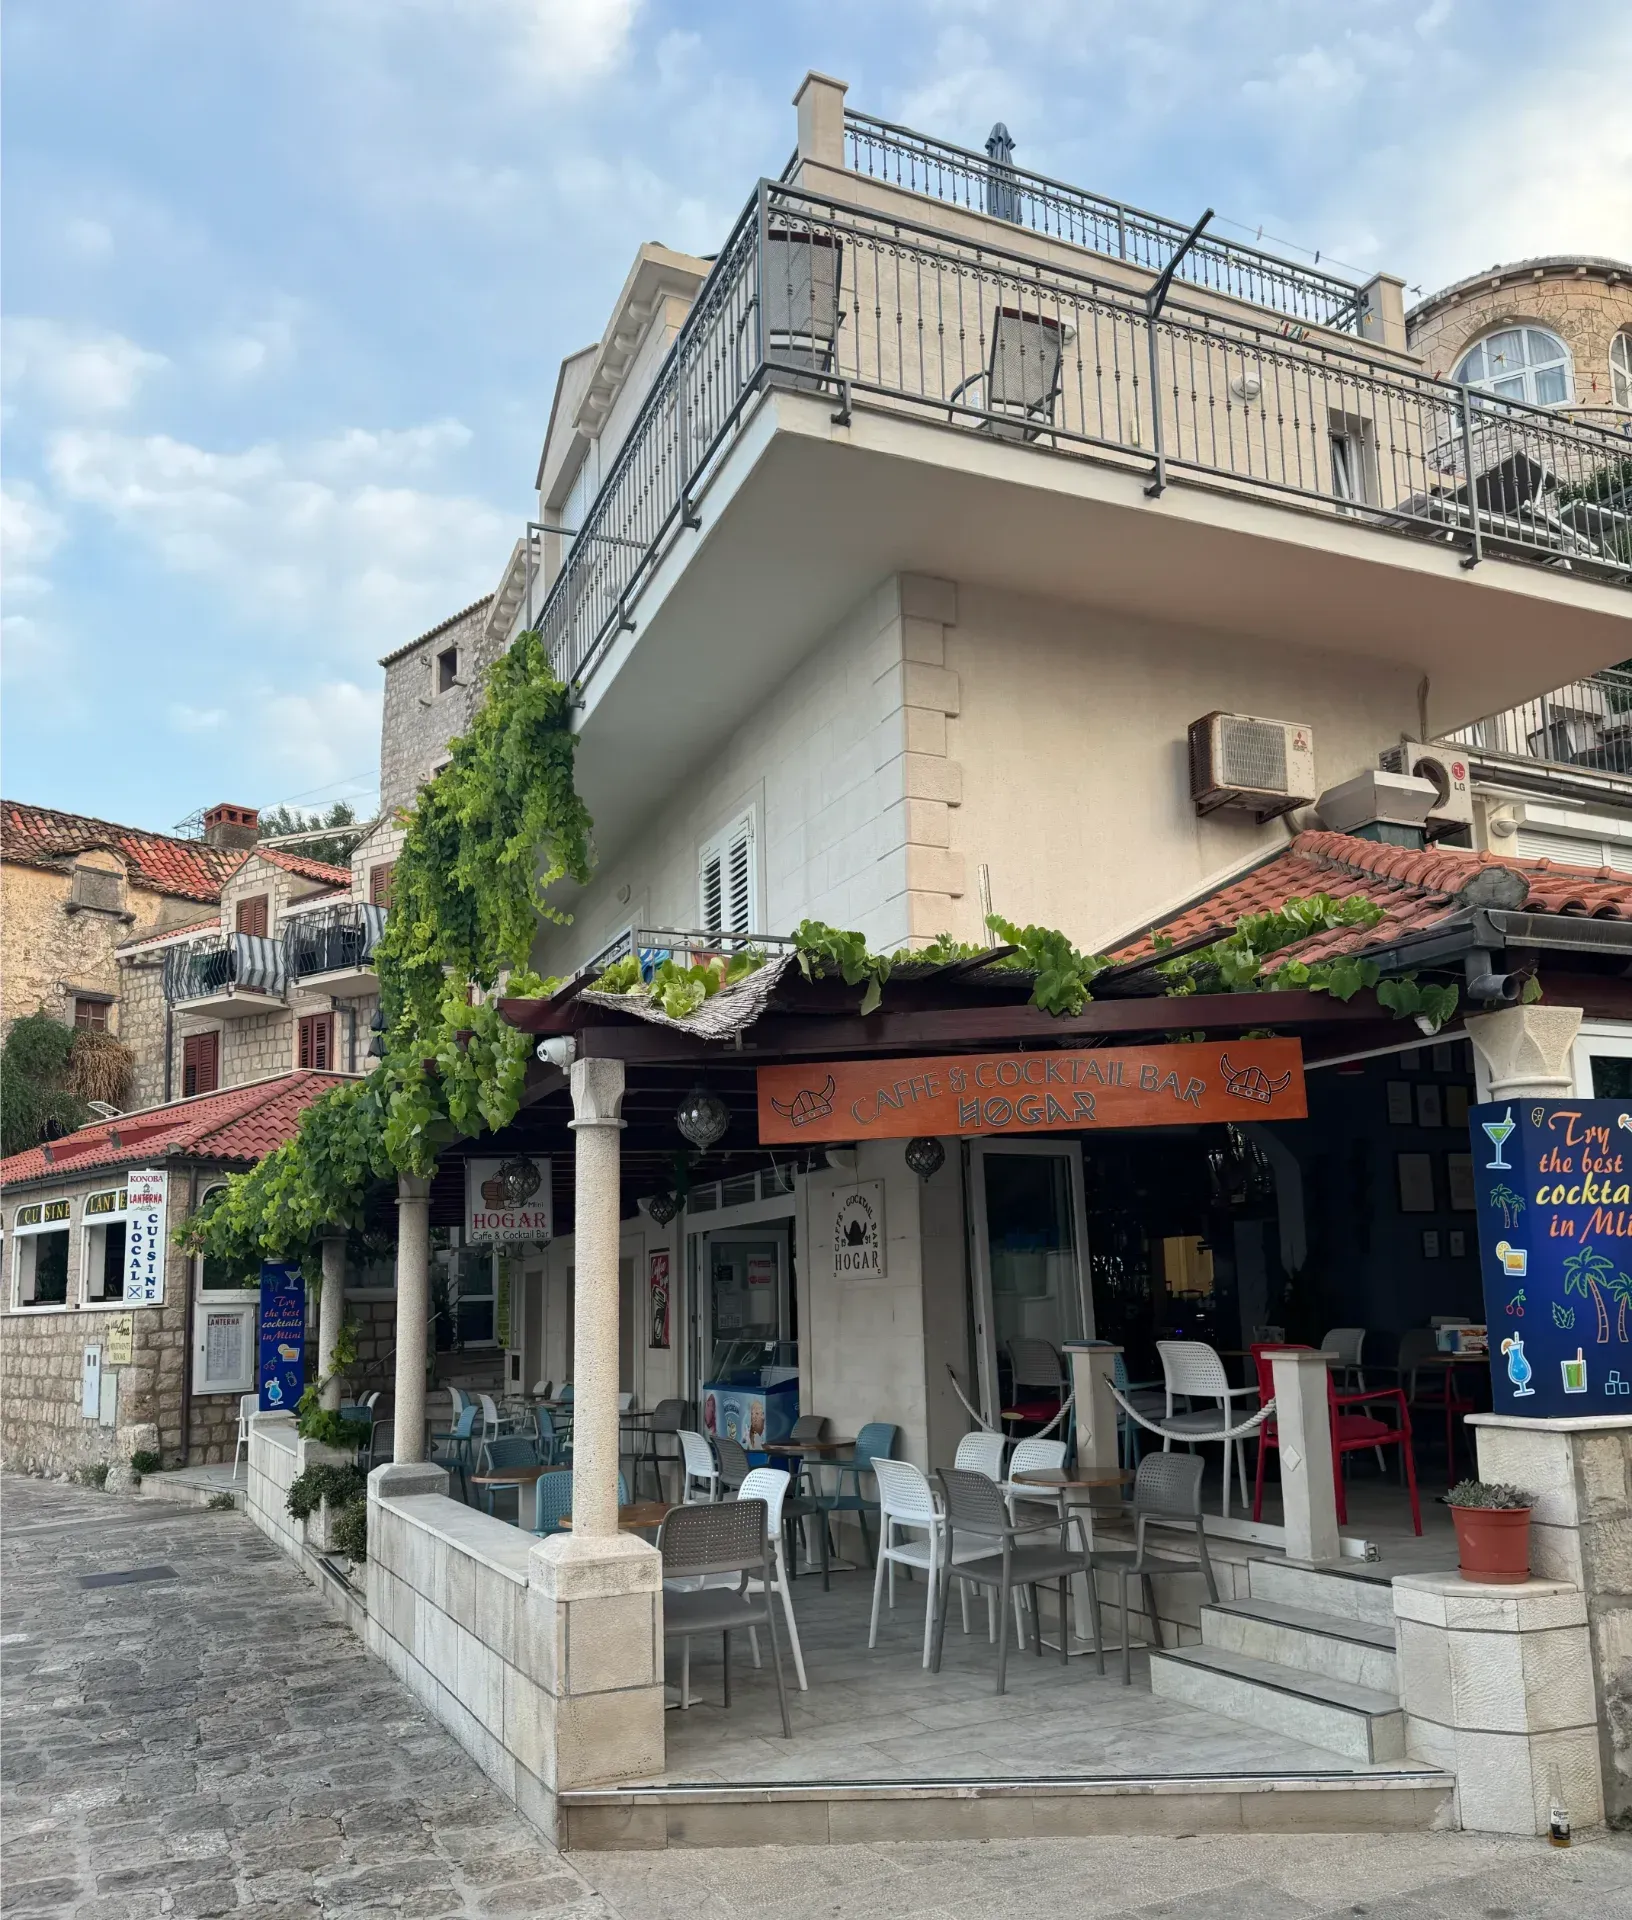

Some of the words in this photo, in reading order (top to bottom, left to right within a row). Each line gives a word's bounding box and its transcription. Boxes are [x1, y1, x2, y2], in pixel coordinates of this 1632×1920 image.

[1454, 782, 1466, 791] LG
[851, 1071, 943, 1126] CAFFE
[949, 1066, 968, 1093] &
[975, 1058, 1132, 1089] COCKTAIL
[1139, 1063, 1207, 1109] BAR
[1548, 1111, 1611, 1155] Try
[1539, 1146, 1573, 1173] the
[1581, 1147, 1624, 1173] best
[130, 1175, 164, 1183] KONOBA
[90, 1191, 127, 1213] LANTE
[130, 1193, 163, 1204] LANTERNA
[846, 1194, 873, 1220] COCKTAIL
[24, 1202, 70, 1224] CUSINE
[473, 1211, 547, 1230] HOGAR
[471, 1231, 492, 1241] Caffe
[494, 1231, 500, 1239] &
[502, 1230, 534, 1240] Cocktail
[536, 1229, 549, 1239] Bar
[1549, 1214, 1575, 1237] in
[130, 1220, 142, 1281] LOCAL
[144, 1213, 158, 1299] CUISINE
[835, 1250, 879, 1271] HOGAR
[273, 1296, 296, 1308] Try
[207, 1317, 240, 1326] LANTERNA
[264, 1308, 279, 1318] the
[282, 1307, 300, 1317] best
[261, 1318, 303, 1328] cocktails
[262, 1333, 272, 1341] in
[270, 1330, 302, 1342] Mlini
